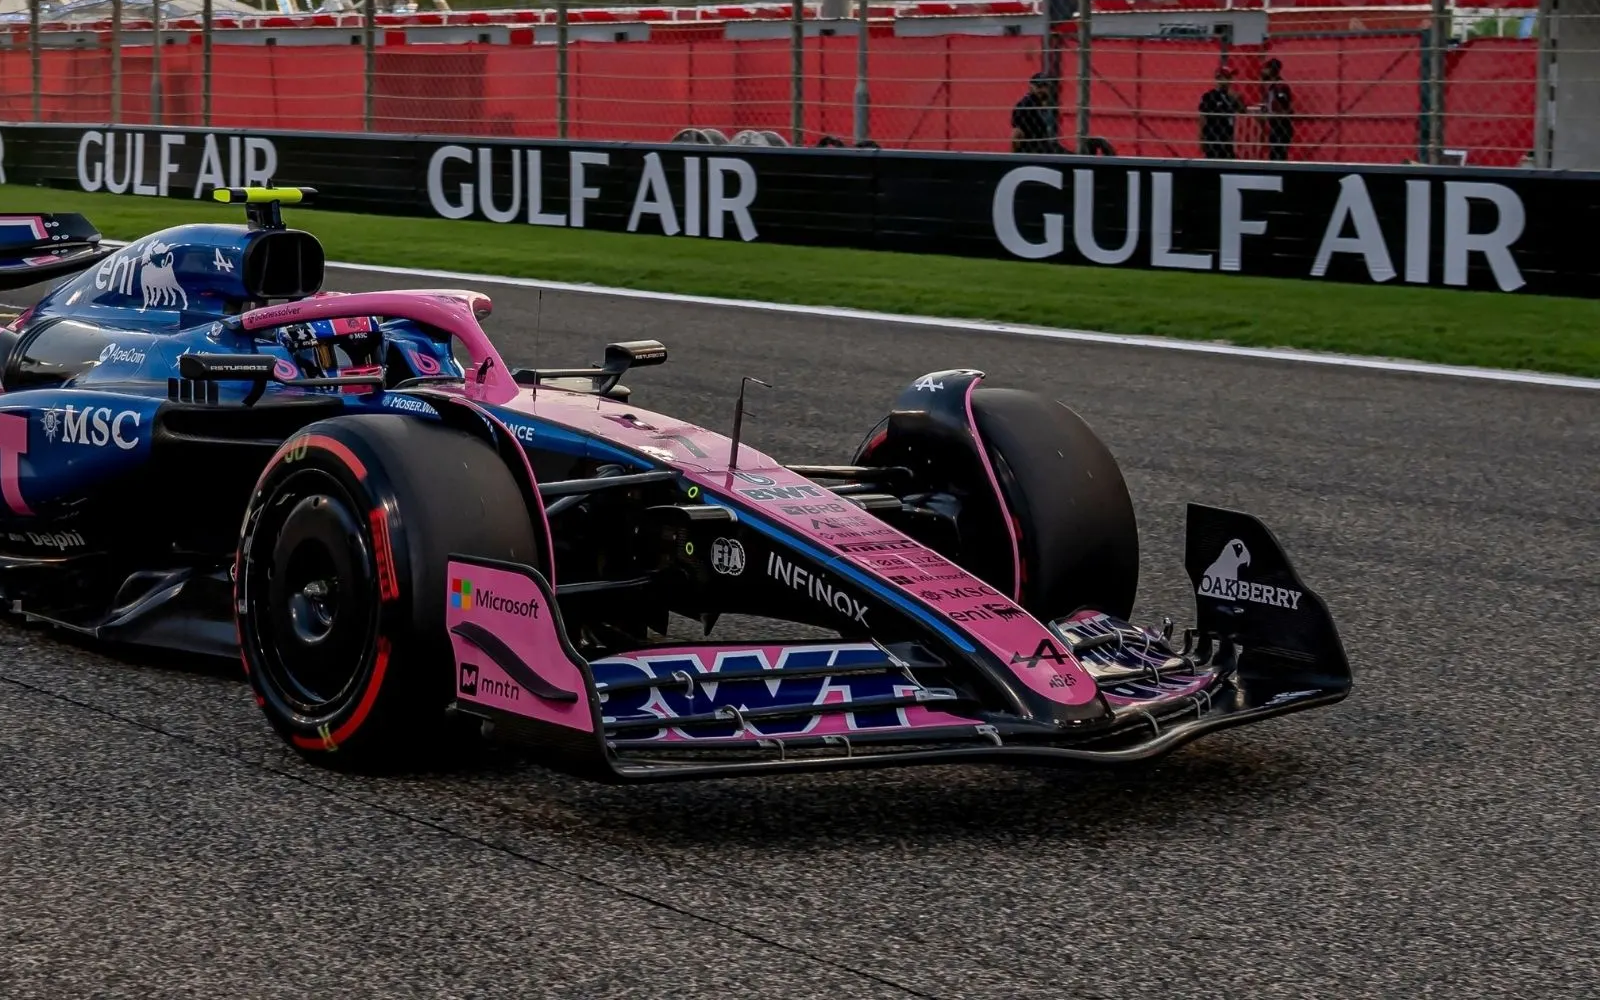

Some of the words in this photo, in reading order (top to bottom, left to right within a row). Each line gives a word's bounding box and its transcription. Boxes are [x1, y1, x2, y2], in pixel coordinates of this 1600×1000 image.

[78, 130, 186, 197] GULF
[193, 133, 278, 199] AIR
[427, 145, 610, 228] GULF
[626, 152, 758, 242] AIR
[992, 166, 1284, 272] GULF
[1310, 173, 1527, 292] AIR
[95, 243, 144, 295] eni
[110, 346, 146, 363] ApeCoin
[390, 396, 438, 415] MOSER.WA
[62, 405, 141, 450] MSC
[503, 421, 536, 442] NCE
[738, 484, 822, 501] BWT
[26, 530, 86, 550] Delphi
[767, 551, 870, 628] INFINOX
[940, 586, 999, 599] MSC
[1198, 575, 1302, 610] OAKBERRY
[475, 588, 539, 620] Microsoft
[949, 605, 993, 622] eni
[481, 677, 520, 701] mntn
